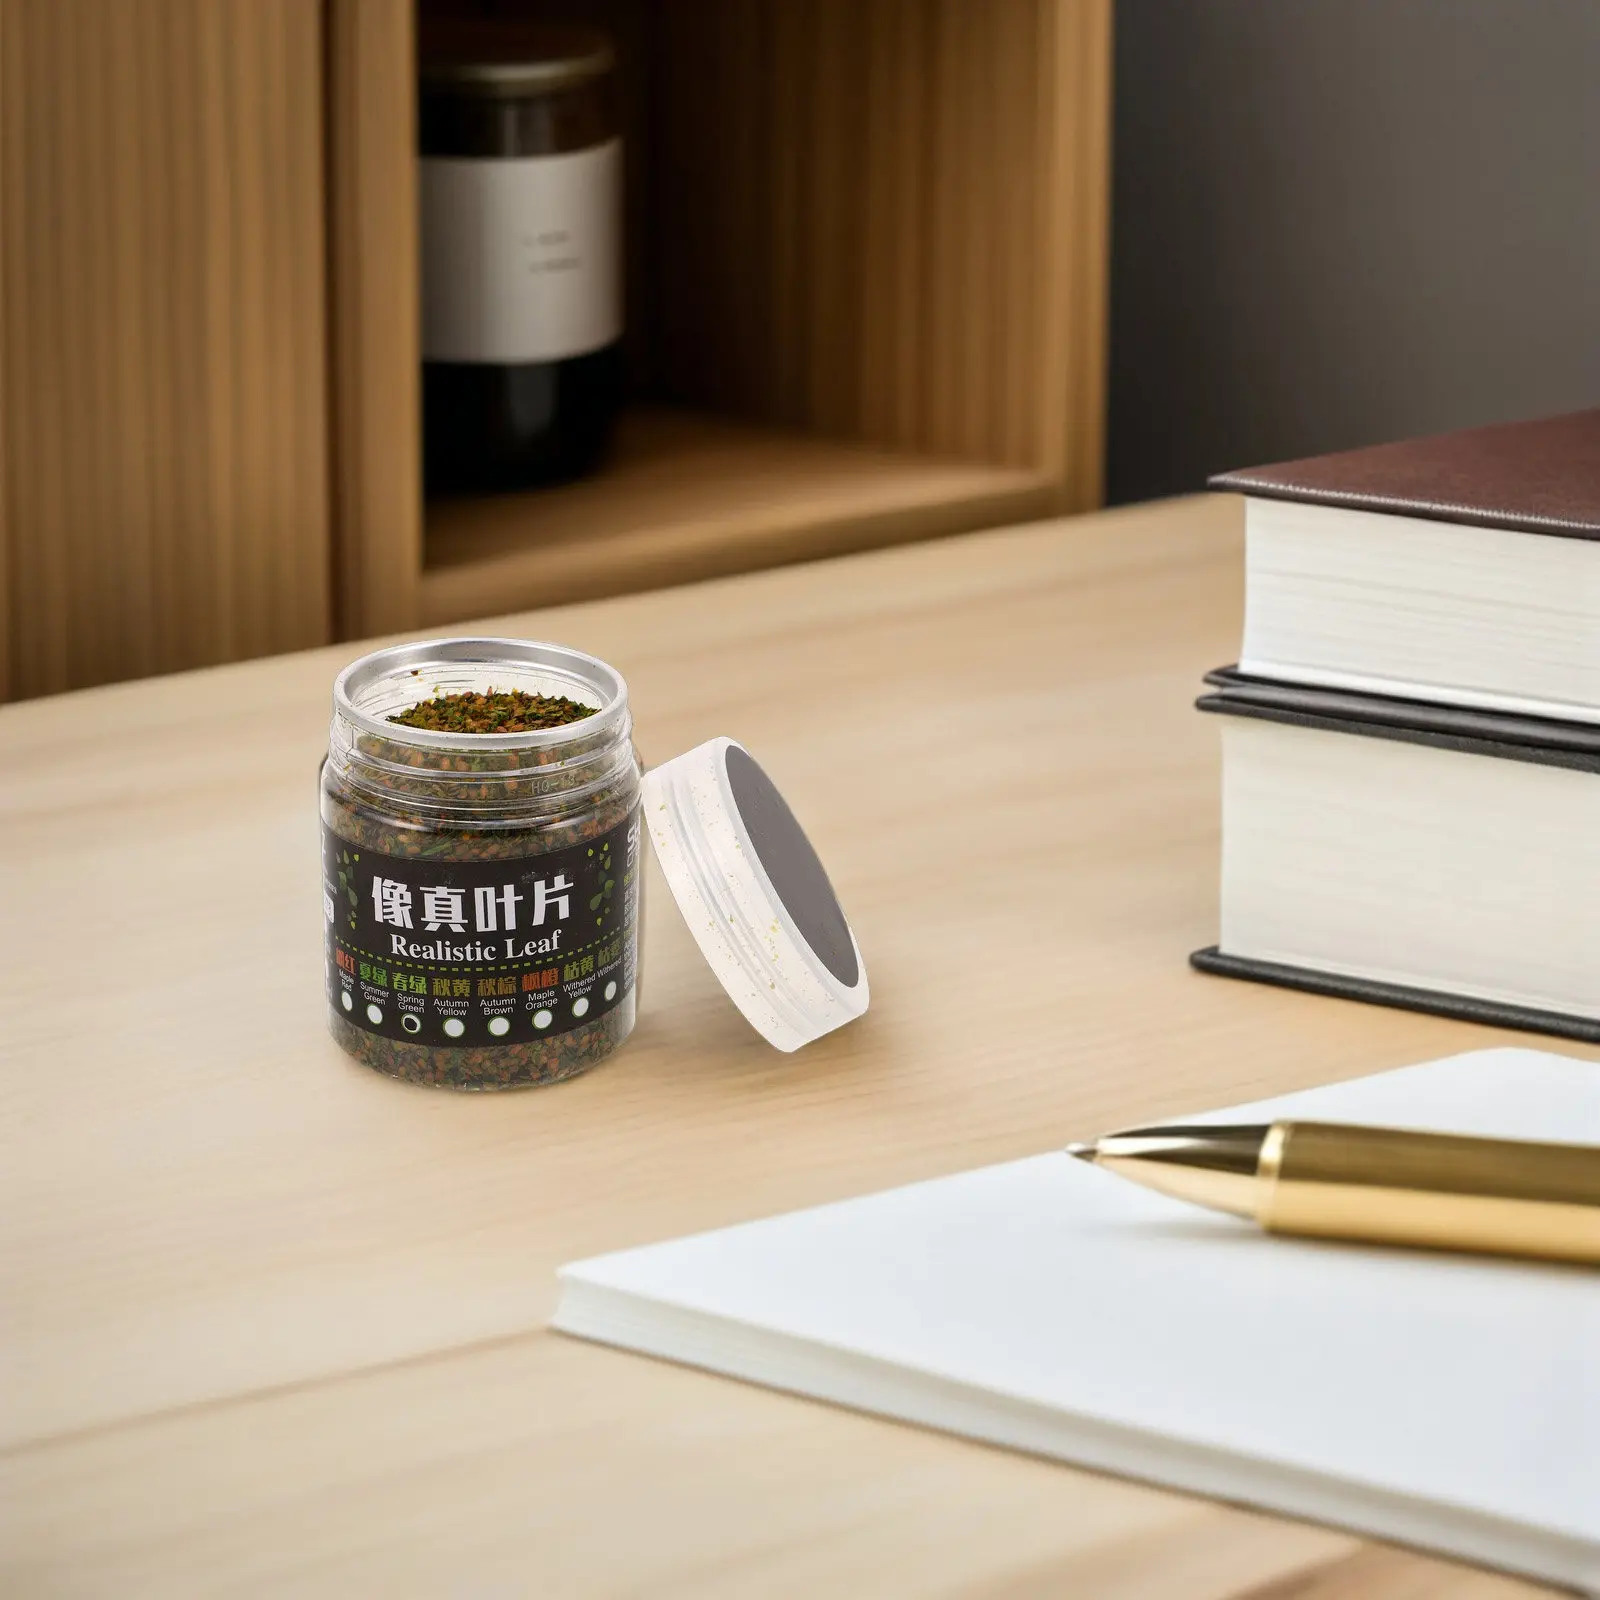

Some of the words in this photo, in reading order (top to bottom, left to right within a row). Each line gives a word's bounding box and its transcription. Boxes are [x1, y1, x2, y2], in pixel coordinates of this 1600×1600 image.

[371, 874, 574, 933] 像真叶片
[390, 933, 497, 962] Realistic
[504, 928, 562, 960] Leaf
[359, 960, 388, 988] 夏绿
[360, 981, 389, 998] Summer
[392, 971, 428, 995] 春绿
[432, 978, 471, 997] 秋黄
[477, 975, 517, 997] 秋棕
[562, 975, 596, 993] Withered
[363, 991, 386, 1006] Green
[528, 990, 555, 1003] Maple
[569, 984, 592, 999] Yellow
[397, 993, 425, 1007] Spring
[433, 998, 469, 1008] Autumn
[480, 997, 516, 1008] Autumn
[525, 997, 558, 1011] Orange
[398, 1002, 425, 1014] Green
[437, 1007, 467, 1016] Yellow
[483, 1005, 514, 1016] Brown
